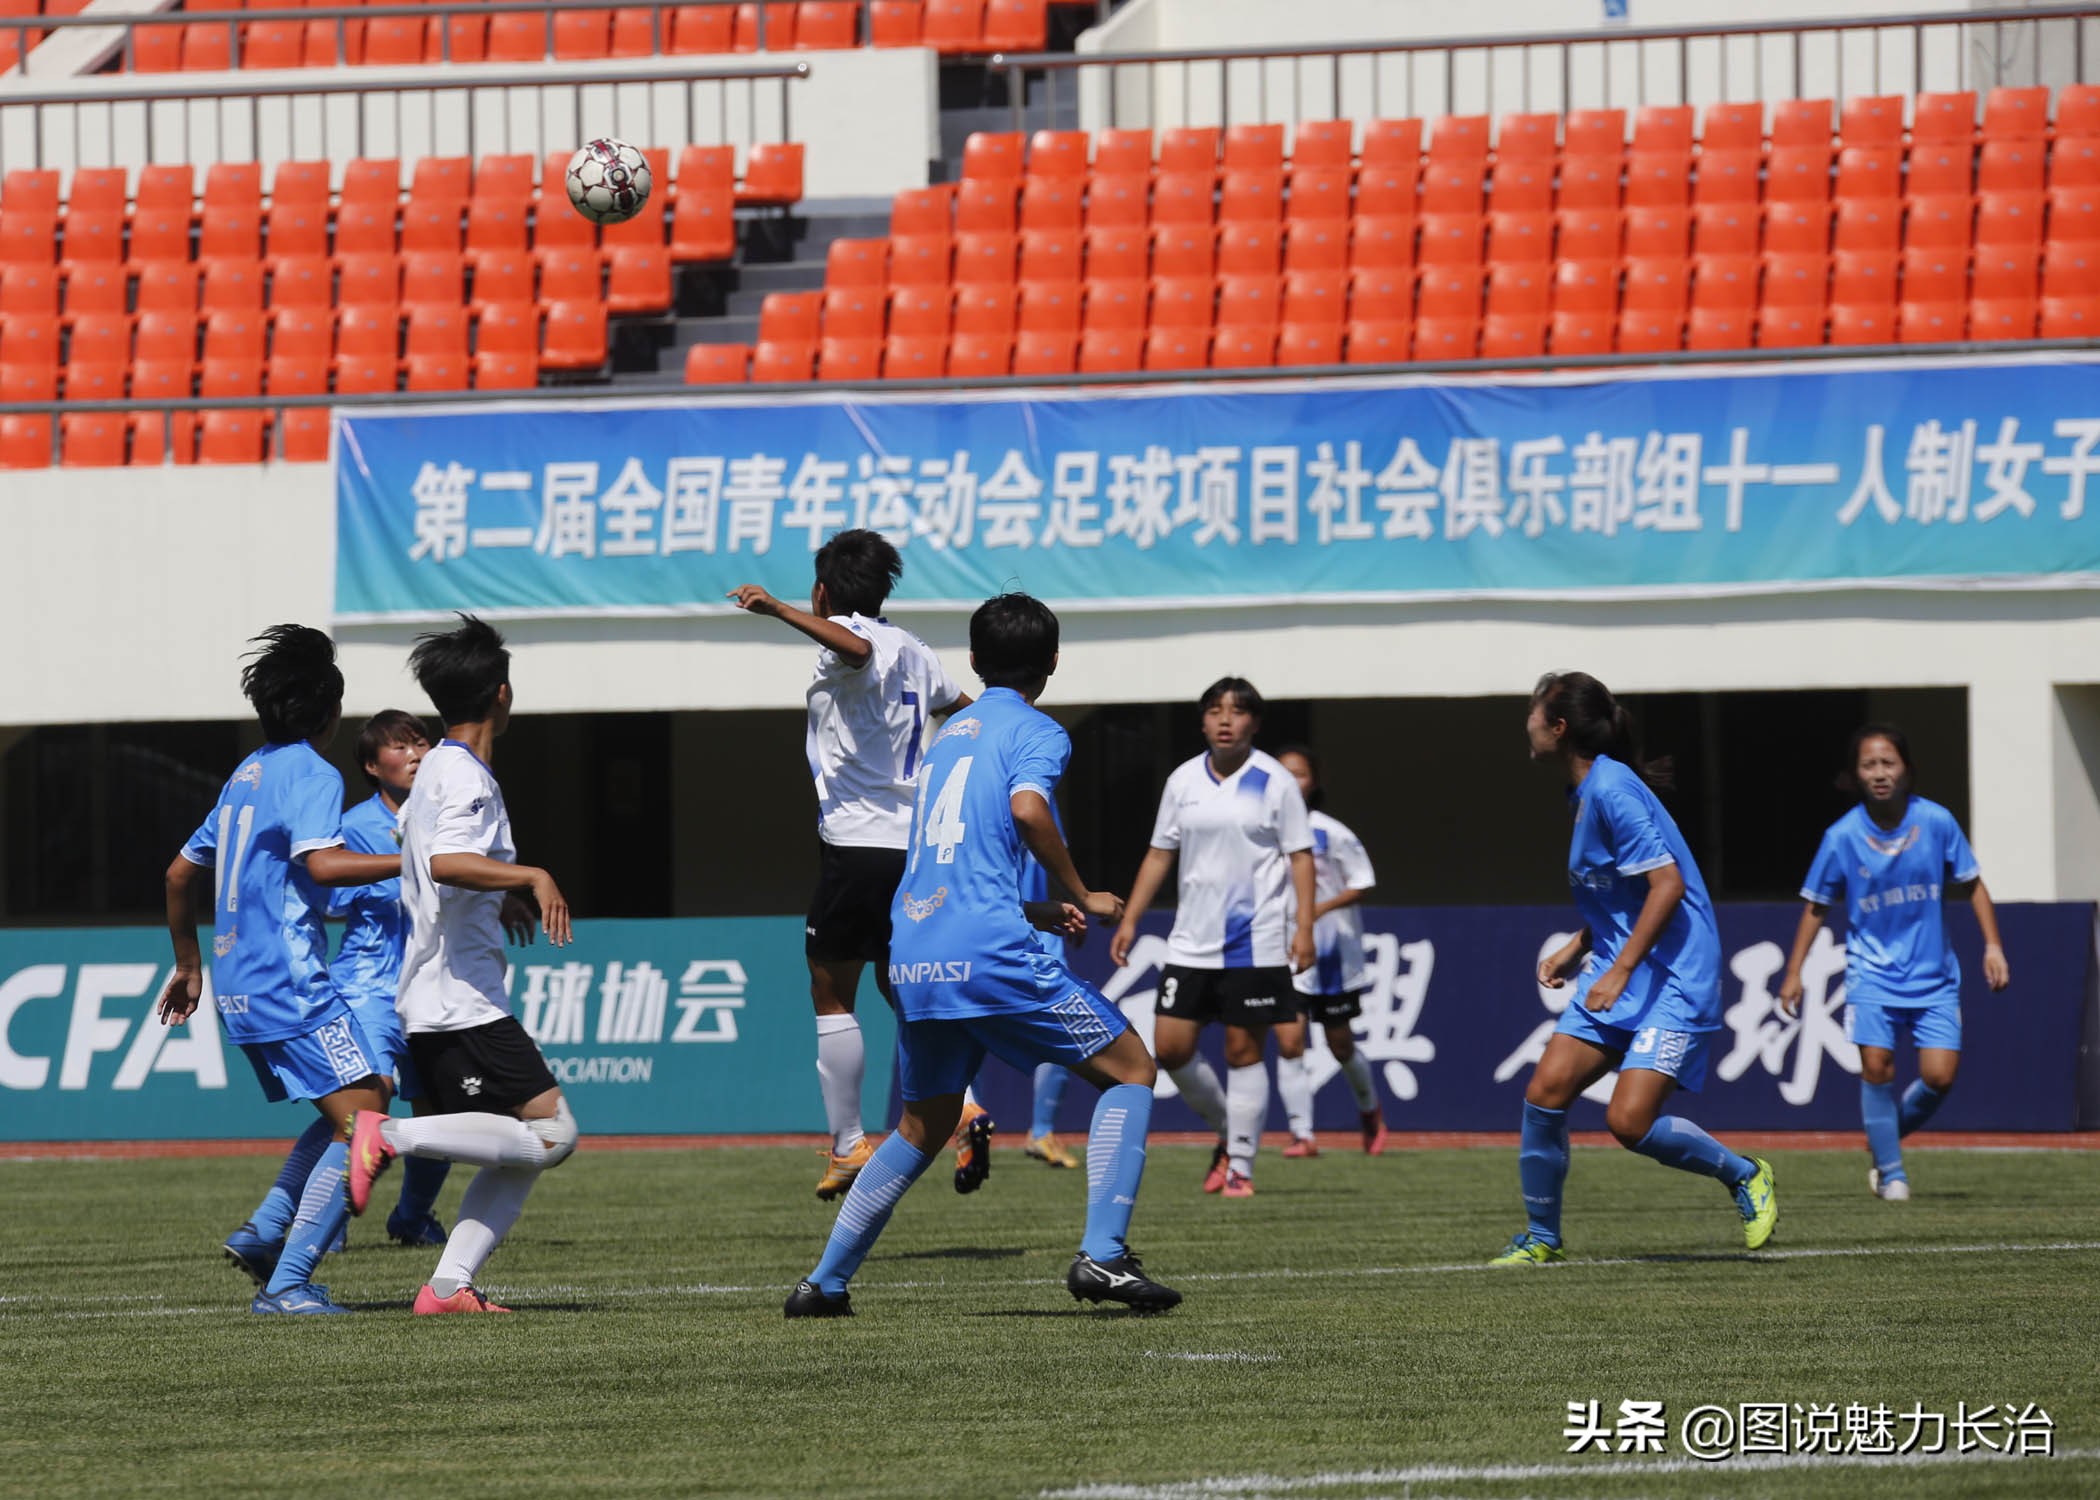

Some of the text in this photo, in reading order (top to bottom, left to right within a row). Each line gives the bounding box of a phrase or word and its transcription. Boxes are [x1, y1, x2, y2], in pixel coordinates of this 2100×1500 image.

[901, 691, 923, 781] 7
[215, 804, 255, 913] 11
[910, 756, 974, 875] 14
[215, 994, 249, 1014] PASI
[503, 959, 749, 1045] 球协会
[888, 961, 972, 985] ANPASI
[1161, 976, 1179, 1010] 3
[0, 963, 228, 1090] CFA
[1632, 1026, 1658, 1054] 3
